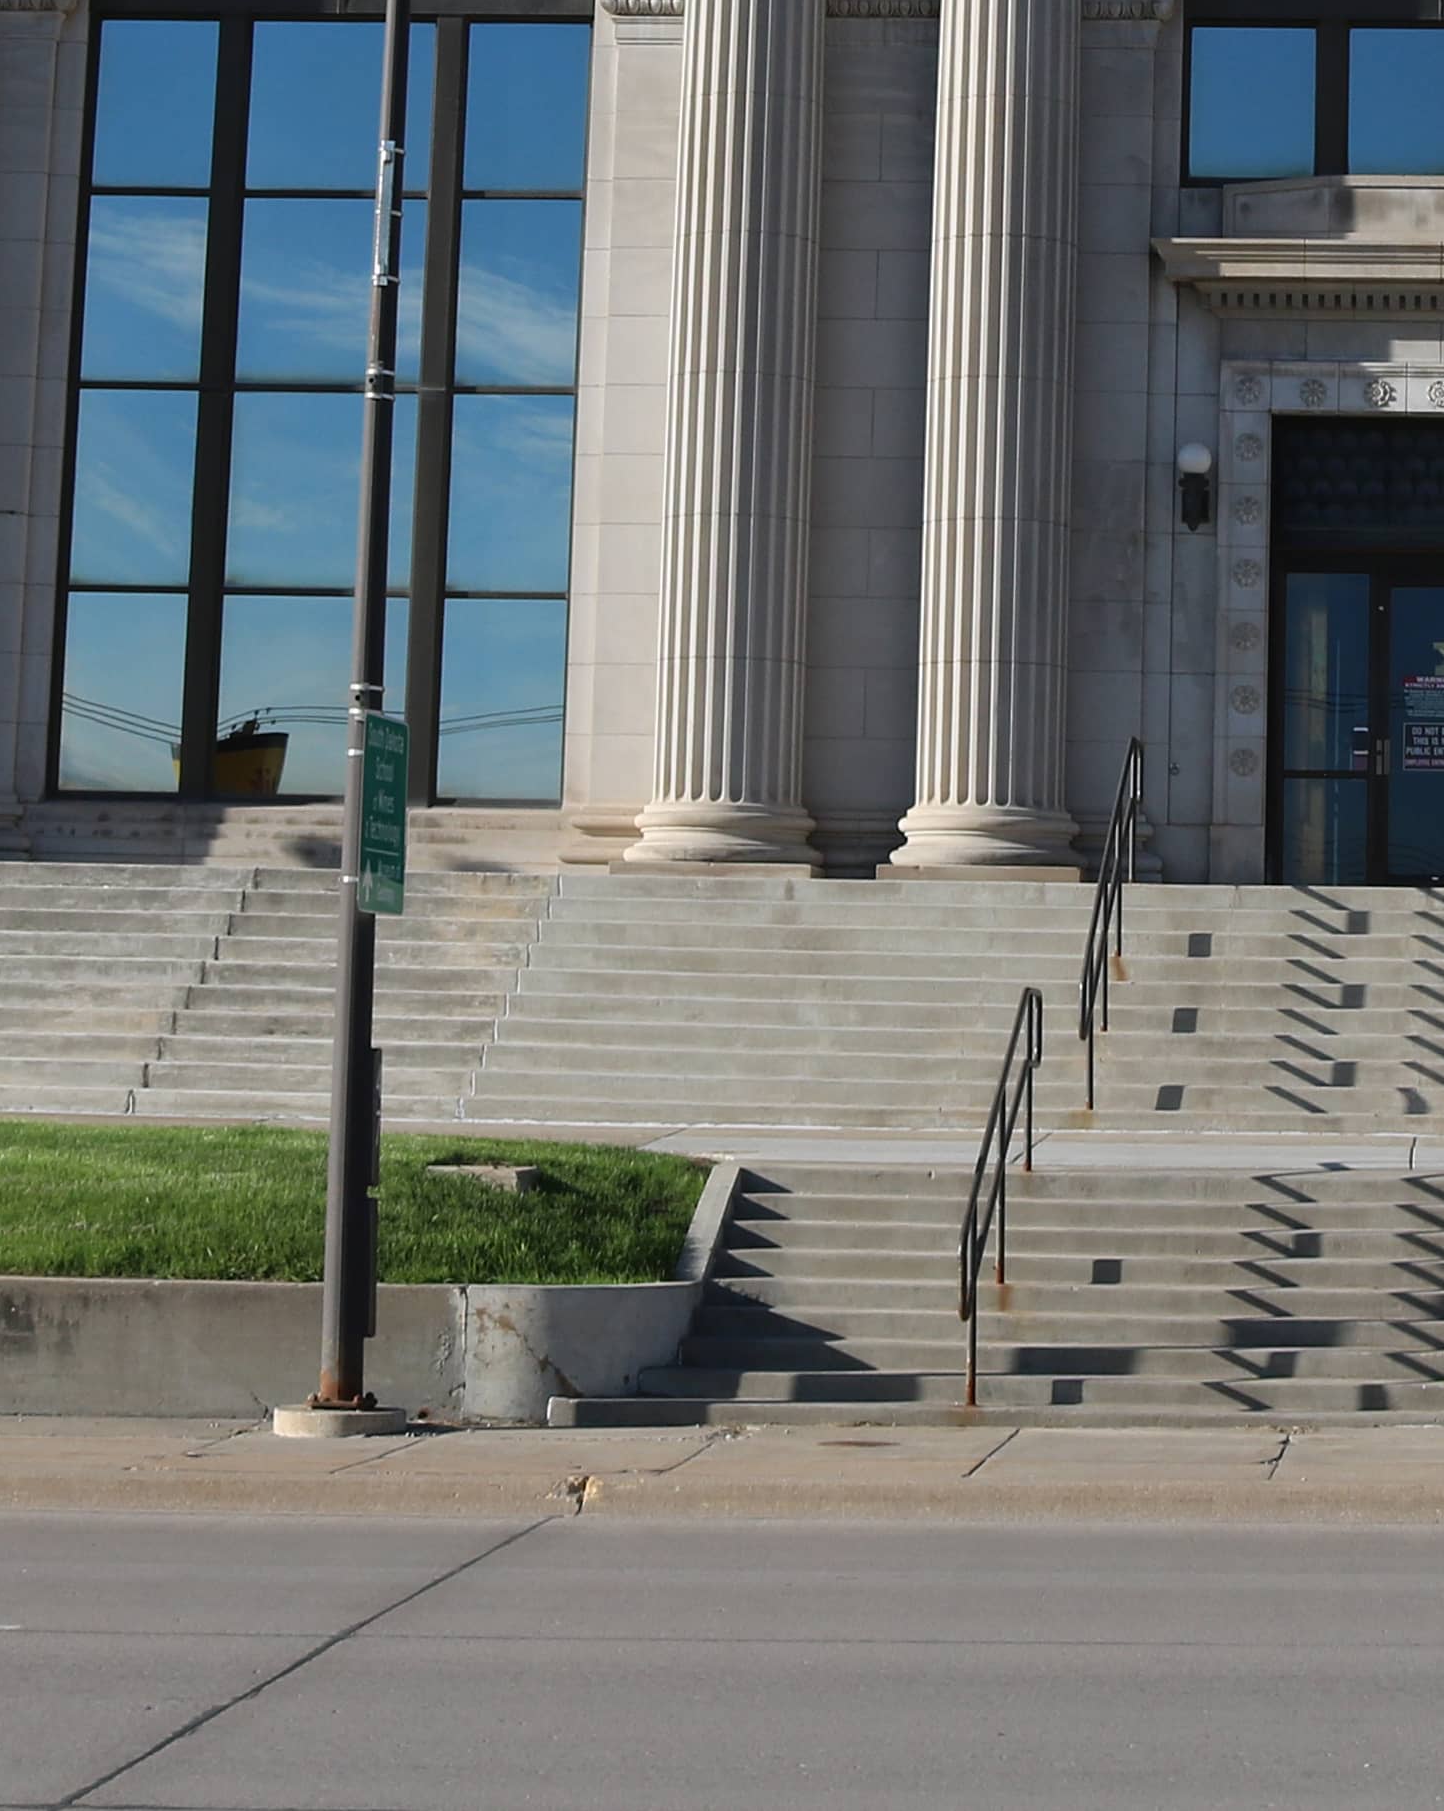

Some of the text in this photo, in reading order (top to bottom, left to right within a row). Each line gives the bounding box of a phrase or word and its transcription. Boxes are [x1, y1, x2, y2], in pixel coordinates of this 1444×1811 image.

[1411, 726, 1423, 735] DO
[1424, 726, 1439, 735] NOT
[1413, 737, 1429, 746] THIS
[1431, 737, 1439, 746] IS
[1405, 747, 1431, 756] PUBLIC
